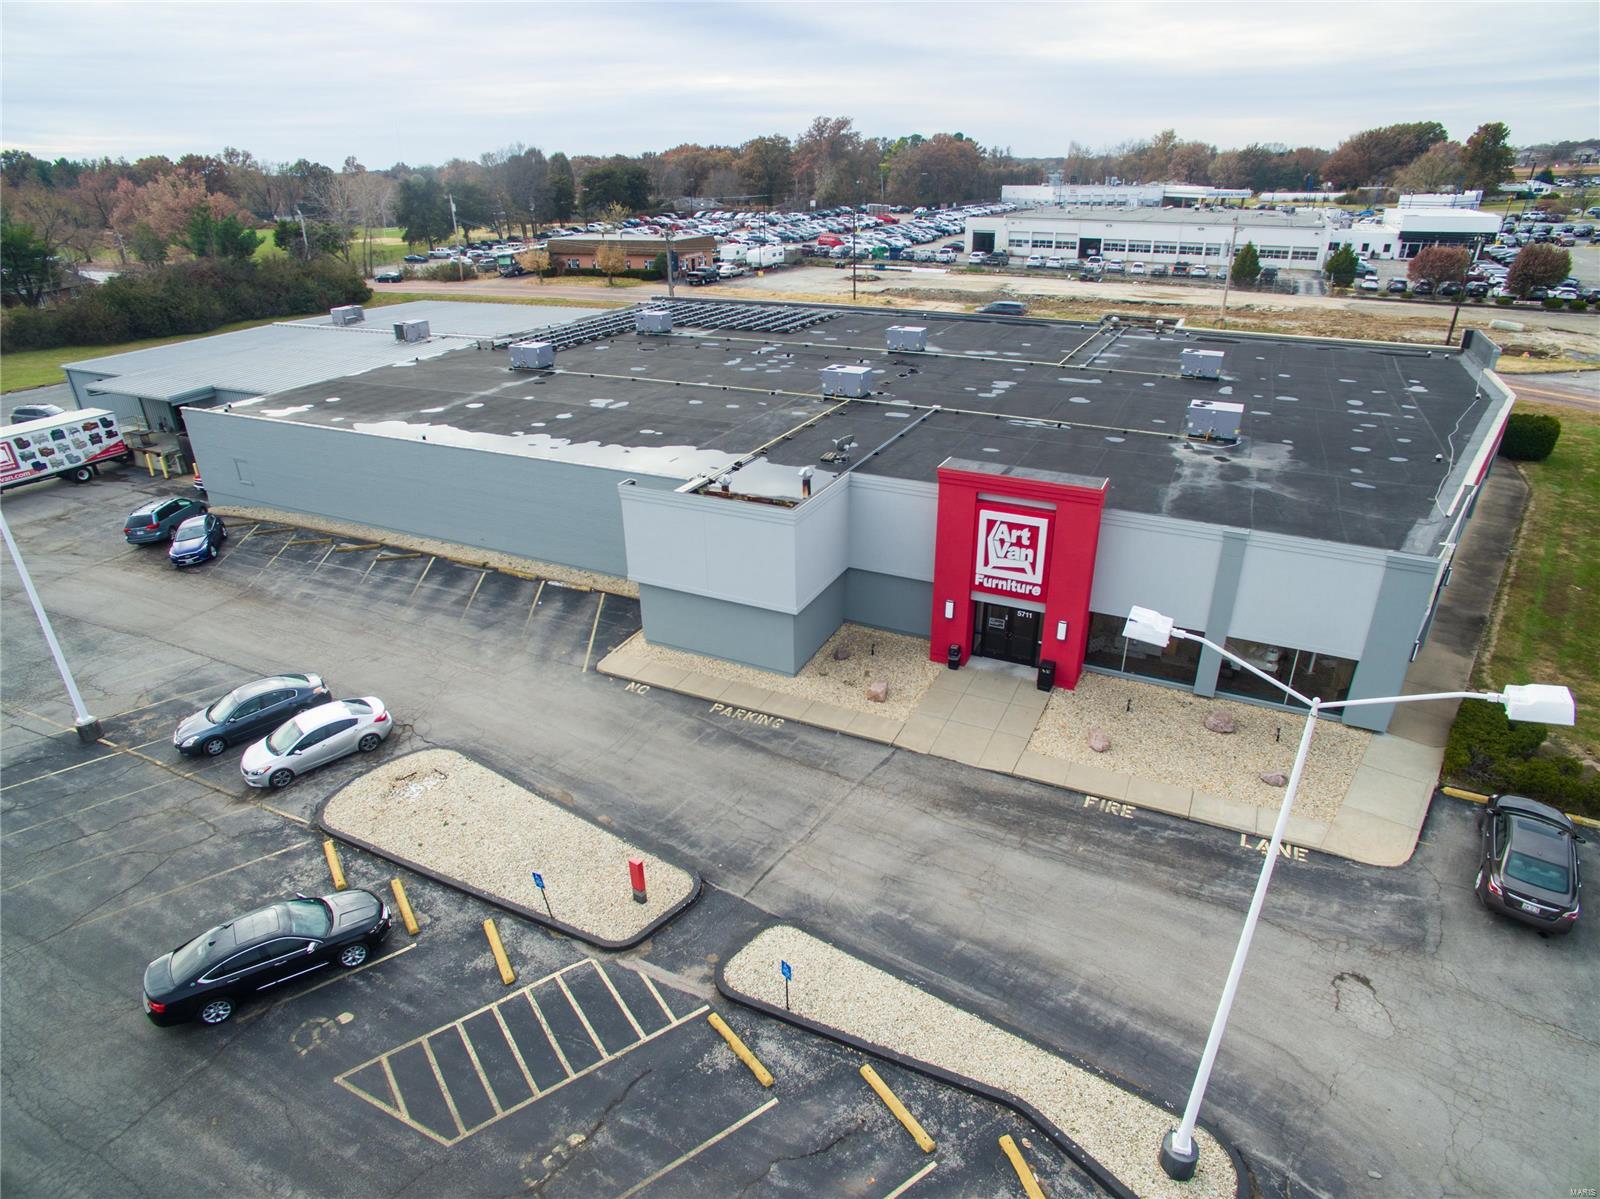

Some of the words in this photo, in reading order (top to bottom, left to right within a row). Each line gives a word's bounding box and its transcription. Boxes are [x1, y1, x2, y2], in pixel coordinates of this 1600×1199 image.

[994, 523, 1031, 545] Art
[994, 540, 1034, 563] Van
[975, 574, 1041, 596] Furniture
[1017, 610, 1032, 619] 5711
[624, 681, 650, 695] NO
[709, 702, 785, 728] PARKING
[1083, 795, 1136, 819] FIRE
